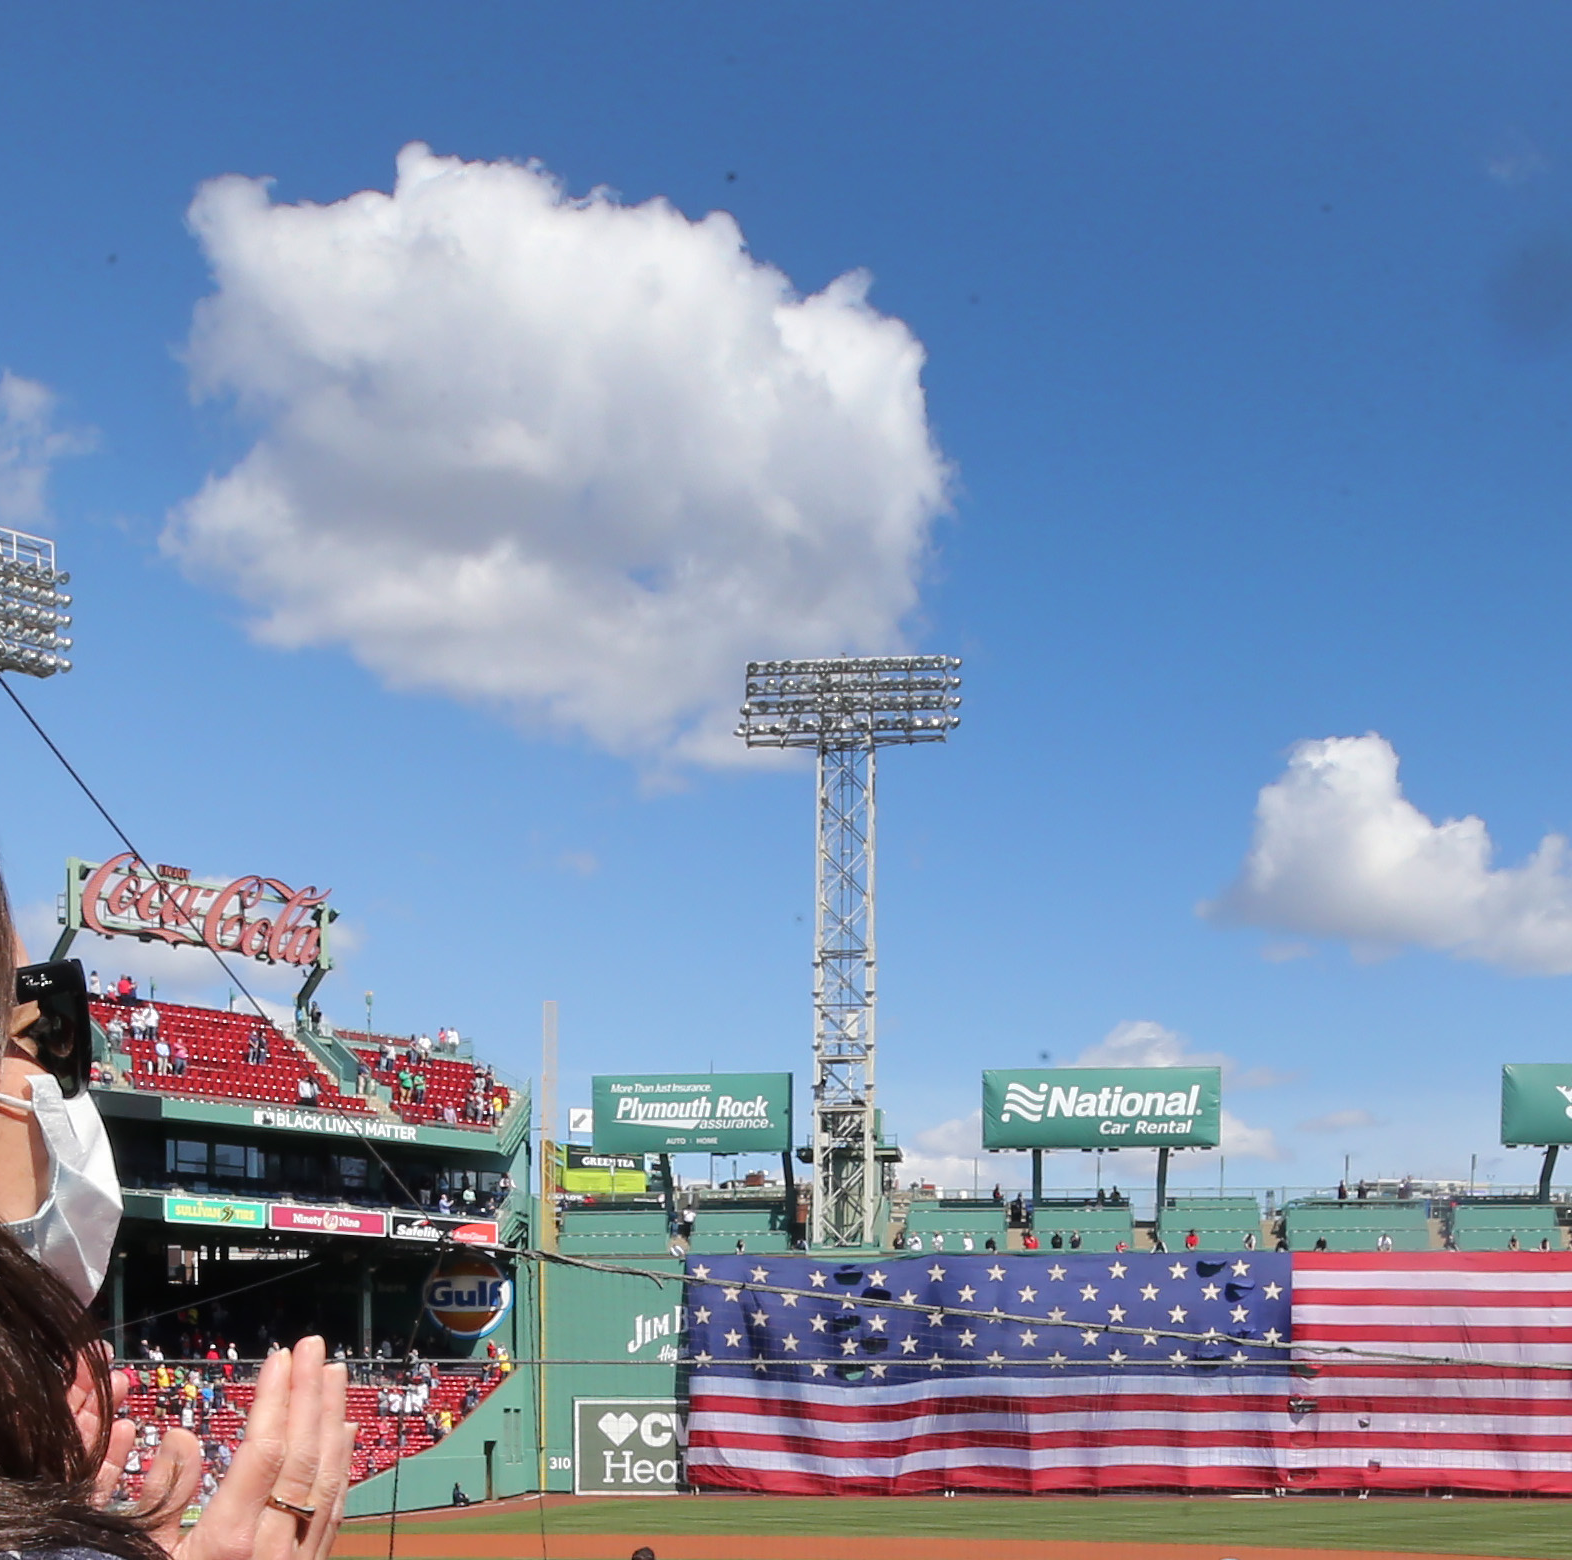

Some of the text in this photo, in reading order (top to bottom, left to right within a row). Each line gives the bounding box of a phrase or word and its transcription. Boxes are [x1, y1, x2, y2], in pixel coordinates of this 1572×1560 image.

[82, 852, 332, 965] Coca-Cola
[610, 1084, 633, 1094] More
[634, 1083, 654, 1093] Than
[655, 1083, 672, 1093] Just
[616, 1095, 769, 1121] Plymouth Rock
[1047, 1084, 1201, 1118] National
[276, 1112, 417, 1141] BLACK LIVES MATTER
[1099, 1119, 1193, 1135] Car Rental
[665, 1137, 687, 1145] AUTO
[581, 1156, 636, 1168] GREEN TEA
[292, 1213, 361, 1228] Ninety Nine
[430, 1280, 502, 1308] Gulf
[627, 1313, 670, 1353] JIM
[549, 1456, 572, 1470] 310
